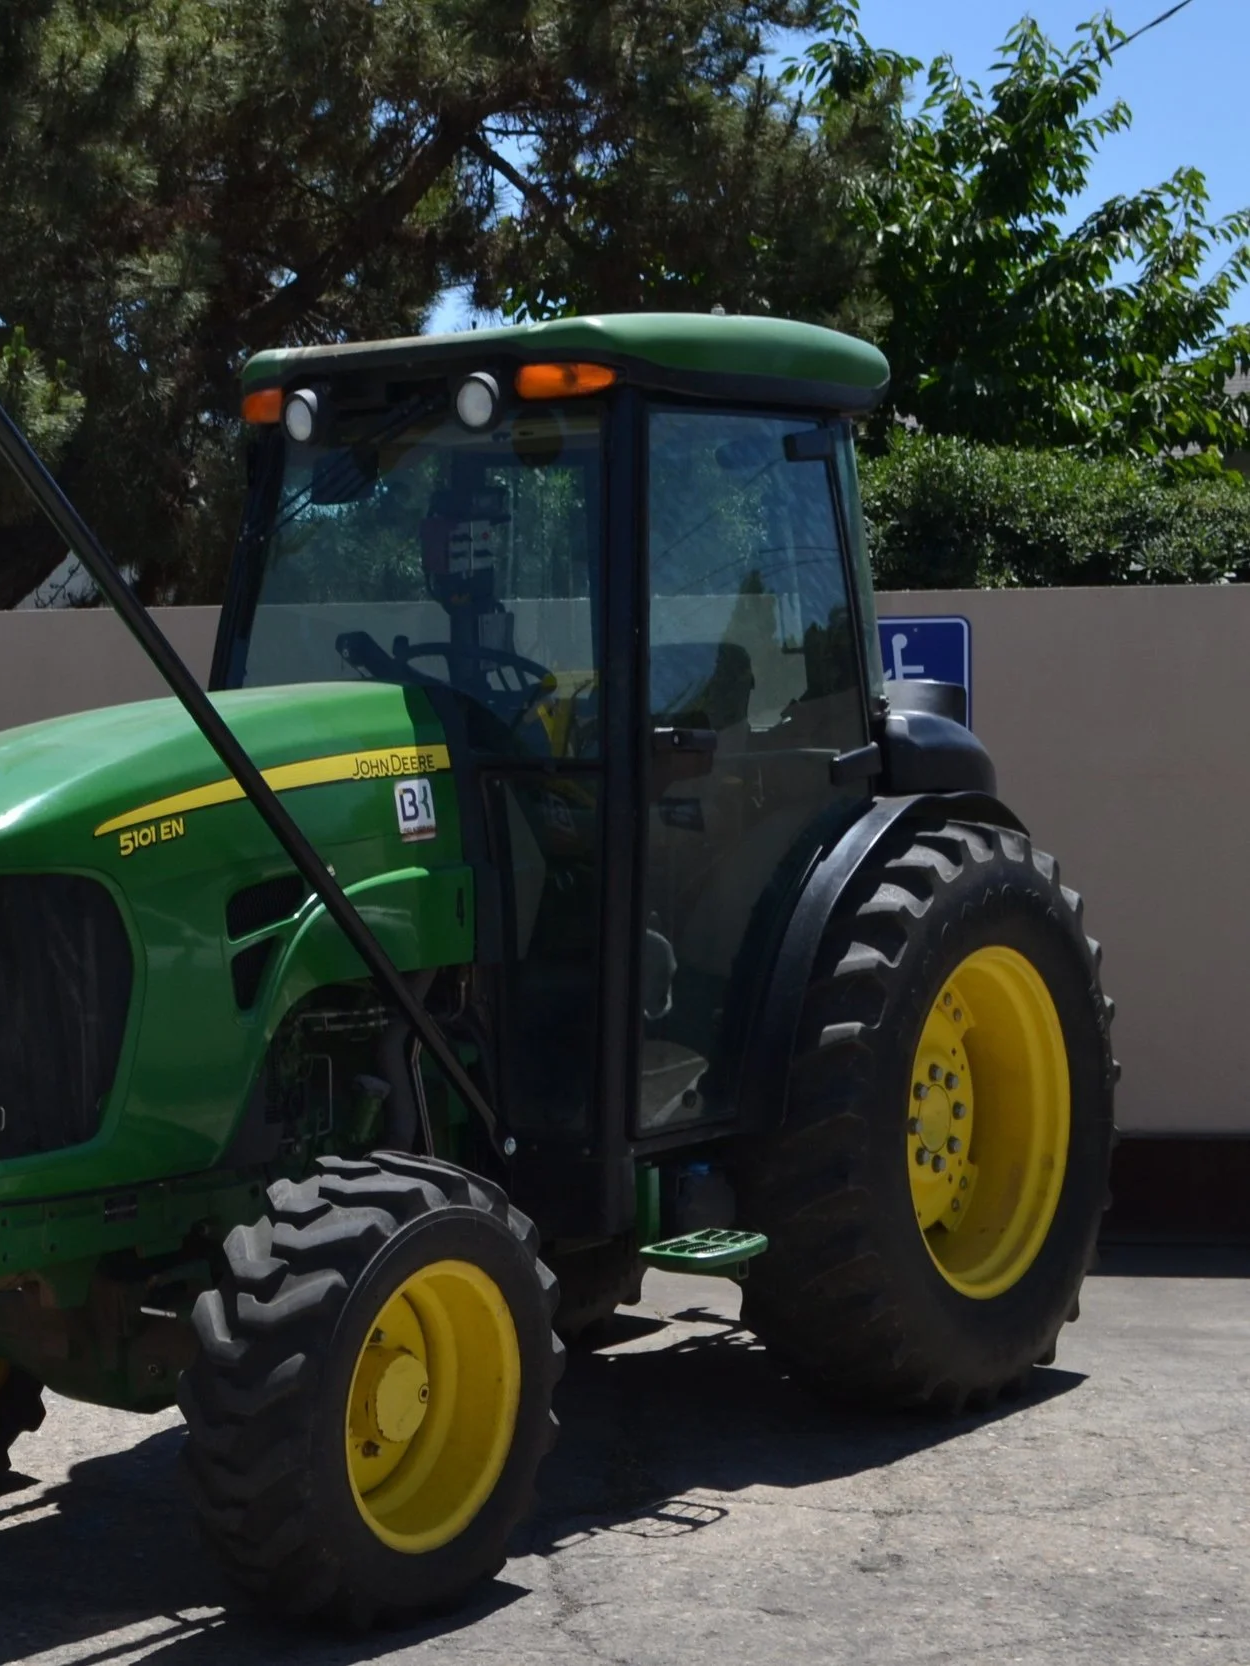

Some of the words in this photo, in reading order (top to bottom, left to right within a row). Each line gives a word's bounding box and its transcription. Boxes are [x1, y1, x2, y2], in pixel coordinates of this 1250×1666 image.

[352, 756, 390, 777] JOHN
[390, 754, 435, 773] DEERE
[119, 825, 156, 856] 5101
[161, 817, 184, 841] EN
